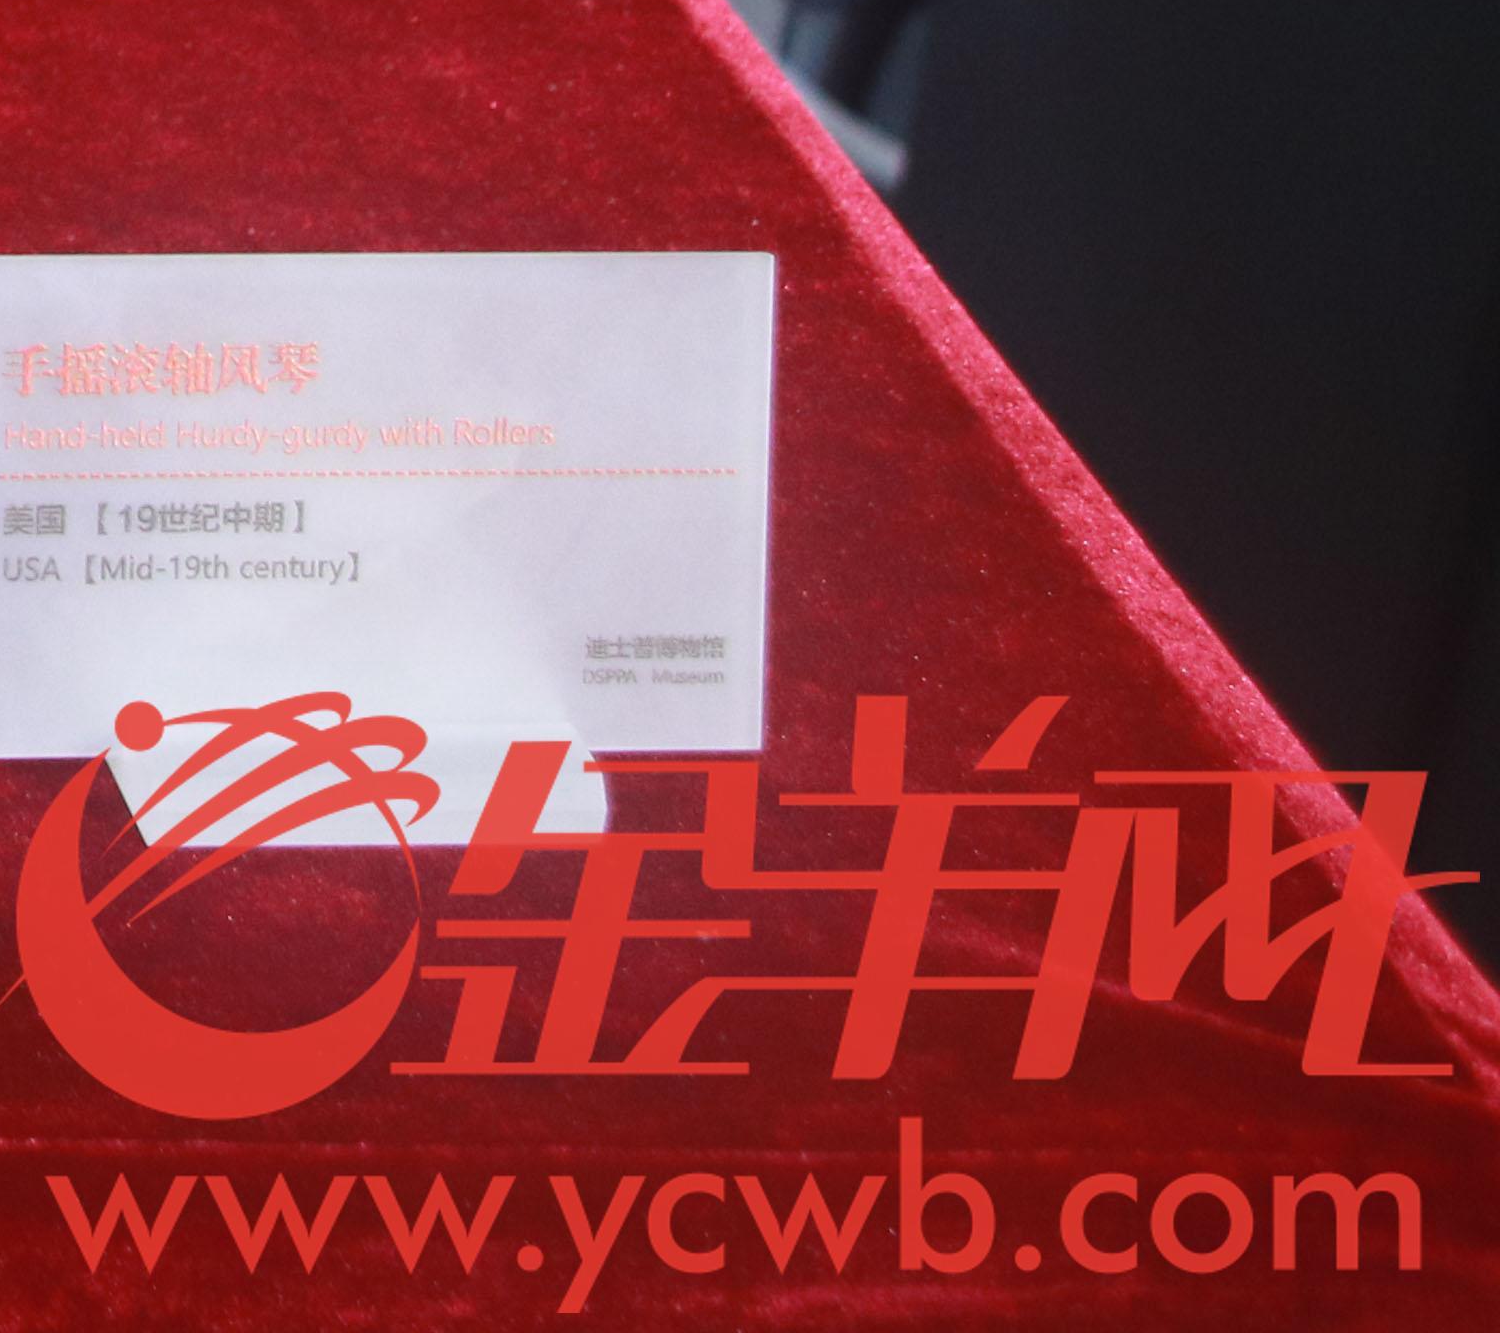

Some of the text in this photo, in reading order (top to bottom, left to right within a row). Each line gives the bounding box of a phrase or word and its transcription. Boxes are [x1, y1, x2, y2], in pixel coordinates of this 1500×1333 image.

[2, 341, 321, 395] 手摇滚轴风琴
[3, 415, 556, 455] Hand-held Hurdy-gurdy with Rollers
[3, 503, 67, 536] 美国
[2, 556, 62, 582] USA
[586, 635, 725, 659] 迪士普博物馆
[583, 668, 724, 684] DSPPA Museum
